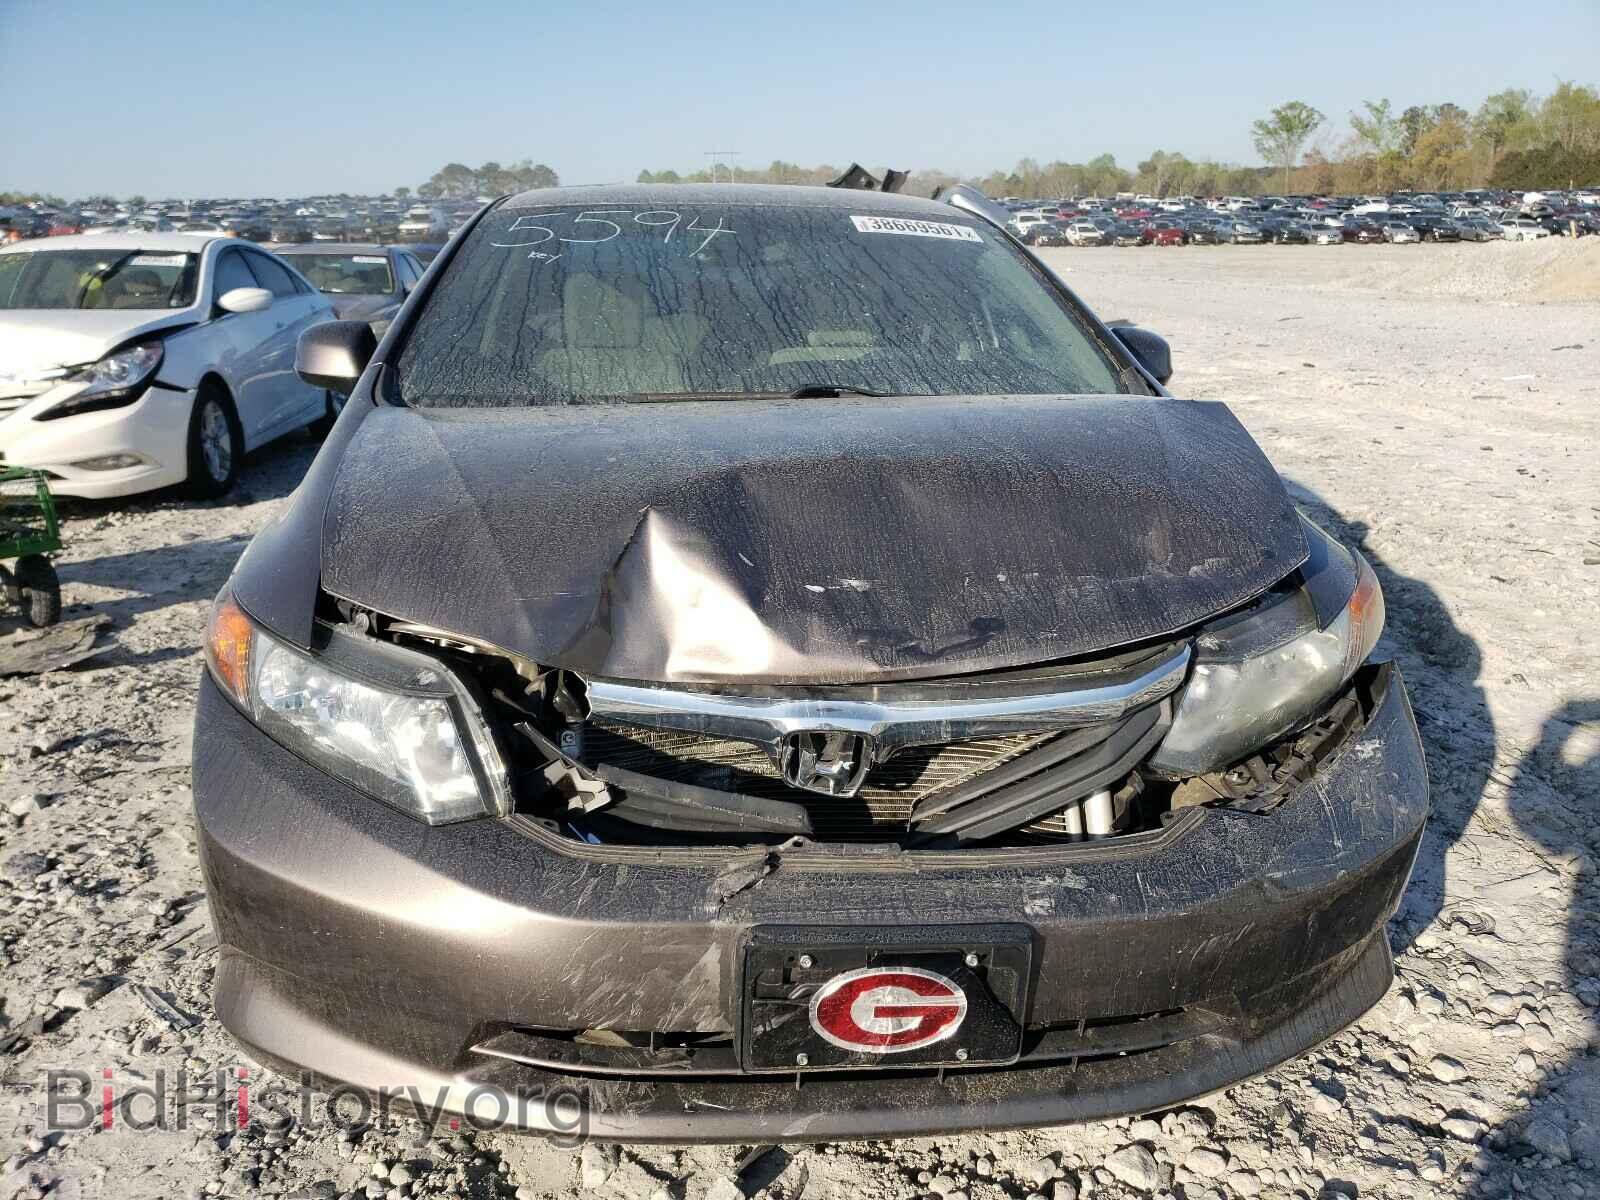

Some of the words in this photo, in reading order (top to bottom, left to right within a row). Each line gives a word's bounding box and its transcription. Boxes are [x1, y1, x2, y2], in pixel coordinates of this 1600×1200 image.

[489, 211, 737, 258] 5594
[866, 217, 962, 238] 38669561
[812, 970, 966, 1052] G
